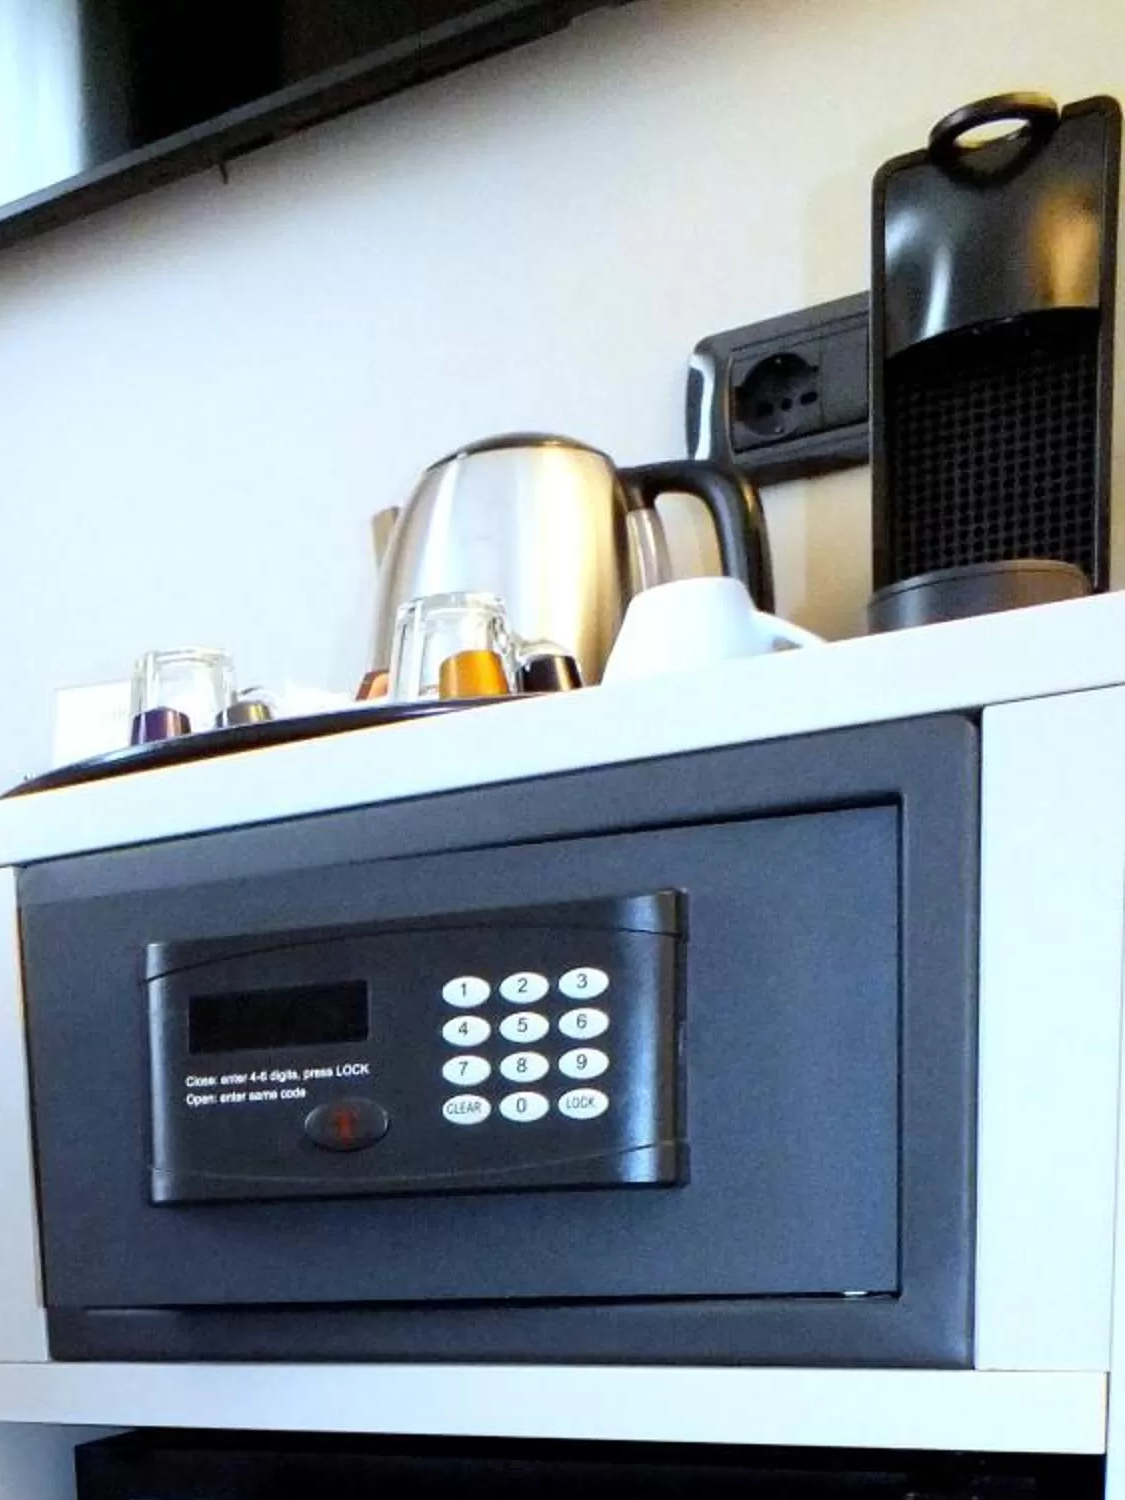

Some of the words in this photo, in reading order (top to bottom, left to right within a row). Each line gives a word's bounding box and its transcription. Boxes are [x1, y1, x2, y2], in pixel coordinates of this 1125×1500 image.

[460, 983, 467, 997] 1
[517, 977, 528, 993] 2
[576, 973, 588, 989] 3
[458, 1021, 468, 1036] 4
[516, 1017, 528, 1033] 5
[576, 1013, 588, 1029] 6
[185, 1075, 217, 1087] Close:
[220, 1073, 247, 1085] enter
[249, 1071, 267, 1083] 4-6
[303, 1067, 333, 1081] press
[336, 1063, 370, 1077] LOCK
[458, 1061, 468, 1076] 7
[516, 1057, 528, 1073] 8
[576, 1053, 588, 1070] 9
[220, 1092, 246, 1104] enter
[249, 1090, 277, 1101] same
[280, 1087, 306, 1099] code
[446, 1101, 482, 1115] CLEAR
[516, 1097, 527, 1113] 0
[566, 1097, 596, 1109] LOCK
